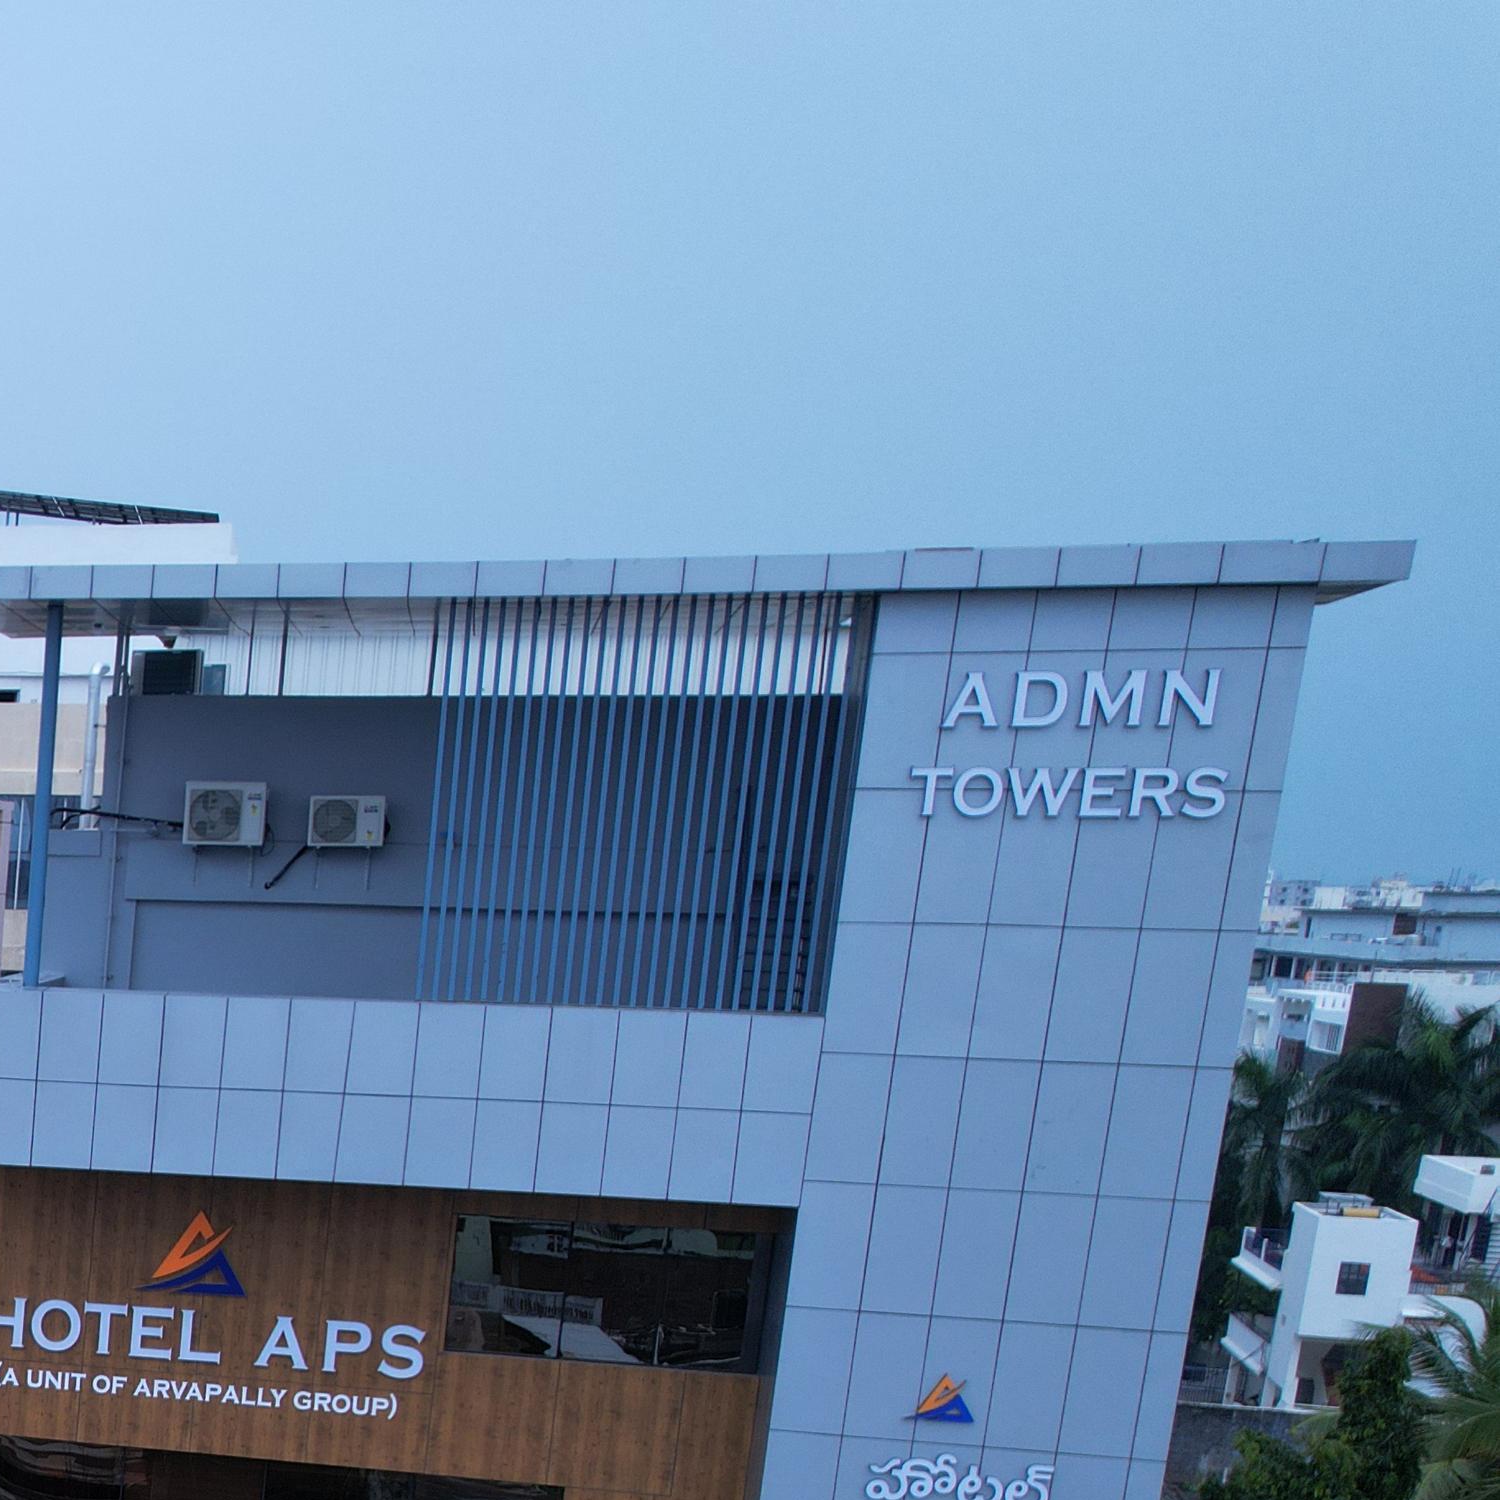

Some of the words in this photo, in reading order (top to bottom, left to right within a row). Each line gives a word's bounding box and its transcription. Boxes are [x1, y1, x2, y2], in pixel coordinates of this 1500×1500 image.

[940, 669, 1222, 729] ADMN
[910, 766, 1230, 819] TOWERS
[253, 1315, 428, 1381] APS
[26, 1369, 87, 1393] UNIT
[92, 1374, 128, 1396] OF
[132, 1376, 288, 1409] ARVAPALLY
[292, 1392, 398, 1420] GROUP)
